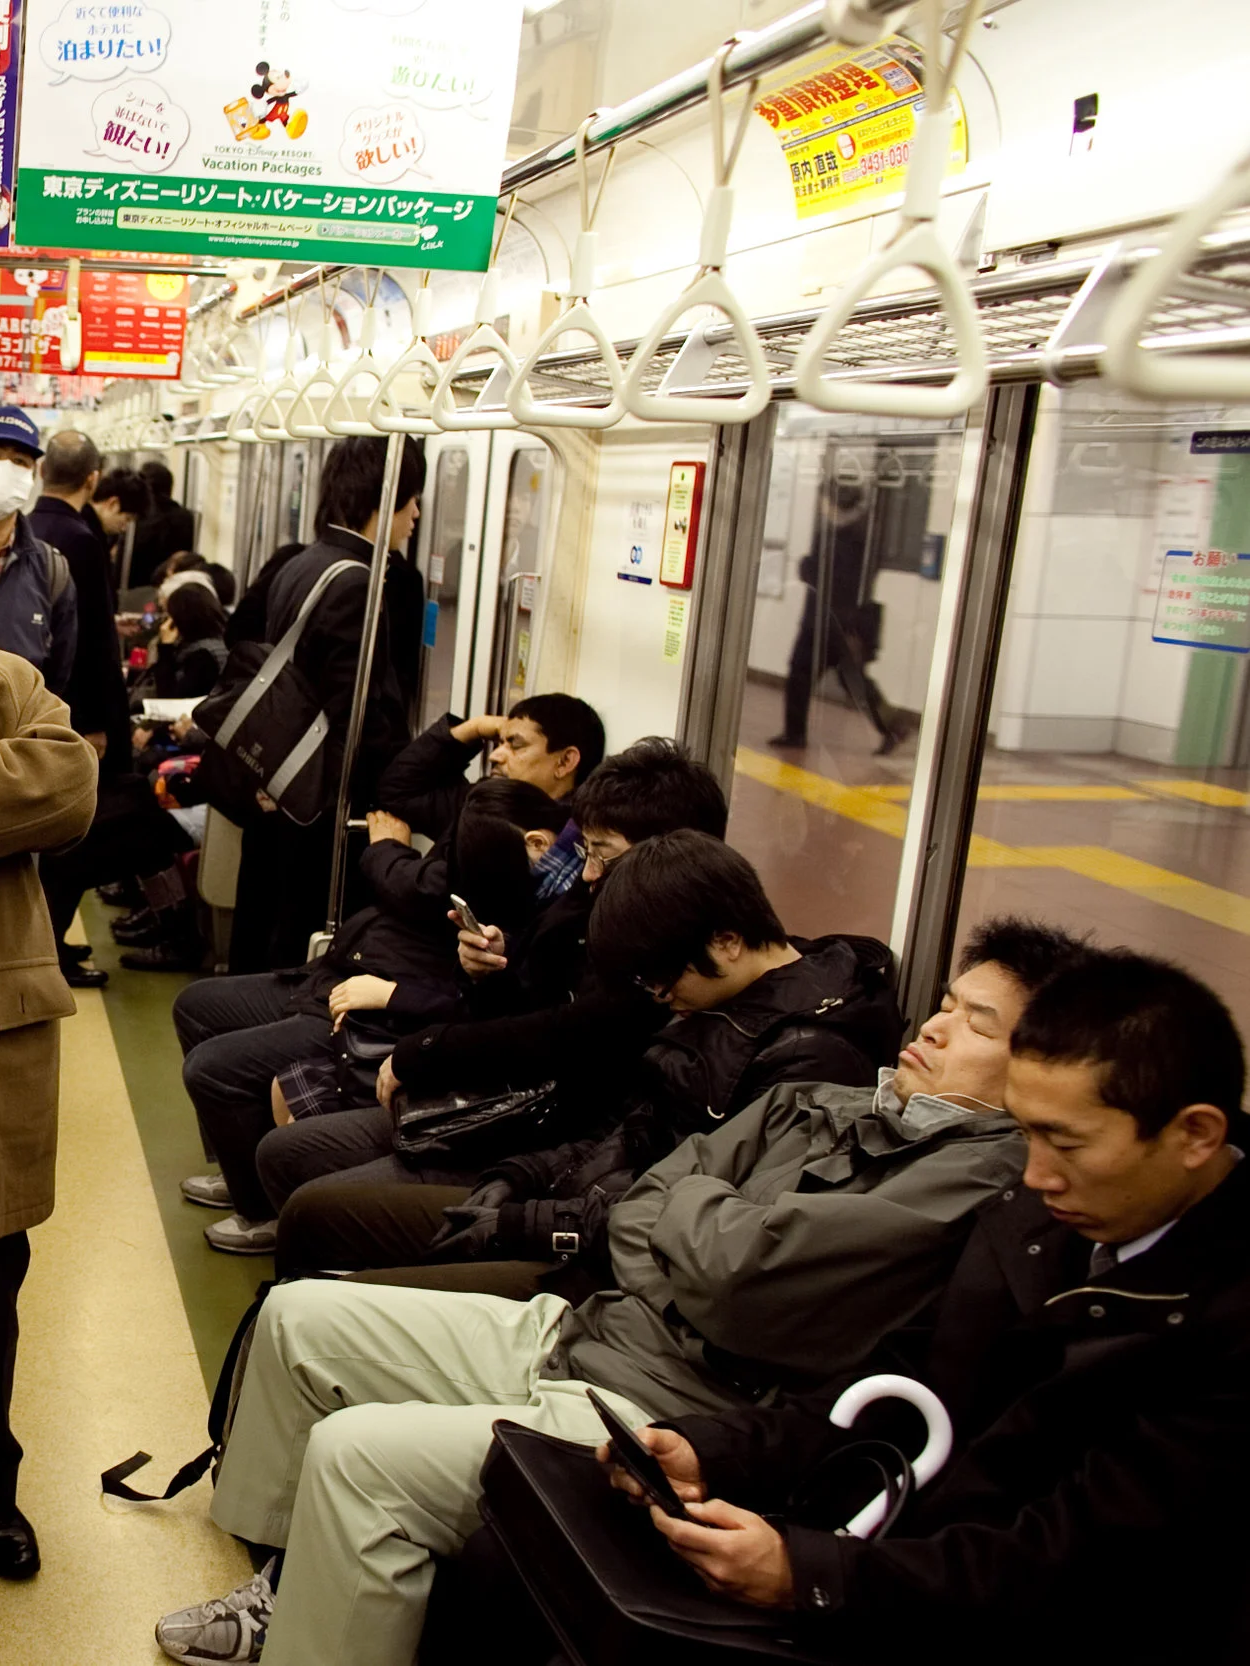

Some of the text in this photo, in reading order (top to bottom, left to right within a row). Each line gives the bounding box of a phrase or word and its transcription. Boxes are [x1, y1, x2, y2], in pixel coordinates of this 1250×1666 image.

[76, 6, 142, 20] 近くて便利な
[87, 24, 135, 35] ホテルに
[58, 38, 161, 62] 泊まりたい!
[125, 91, 165, 114] ショーを
[354, 112, 405, 134] オリジナル
[103, 120, 171, 160] 観たい!
[215, 145, 244, 154] TOKYO
[246, 142, 278, 159] Disney
[354, 137, 418, 171] 欲しい!
[860, 142, 915, 176] 3431-030
[202, 157, 322, 177] Vacation Packages
[1192, 550, 1238, 568] お願い
